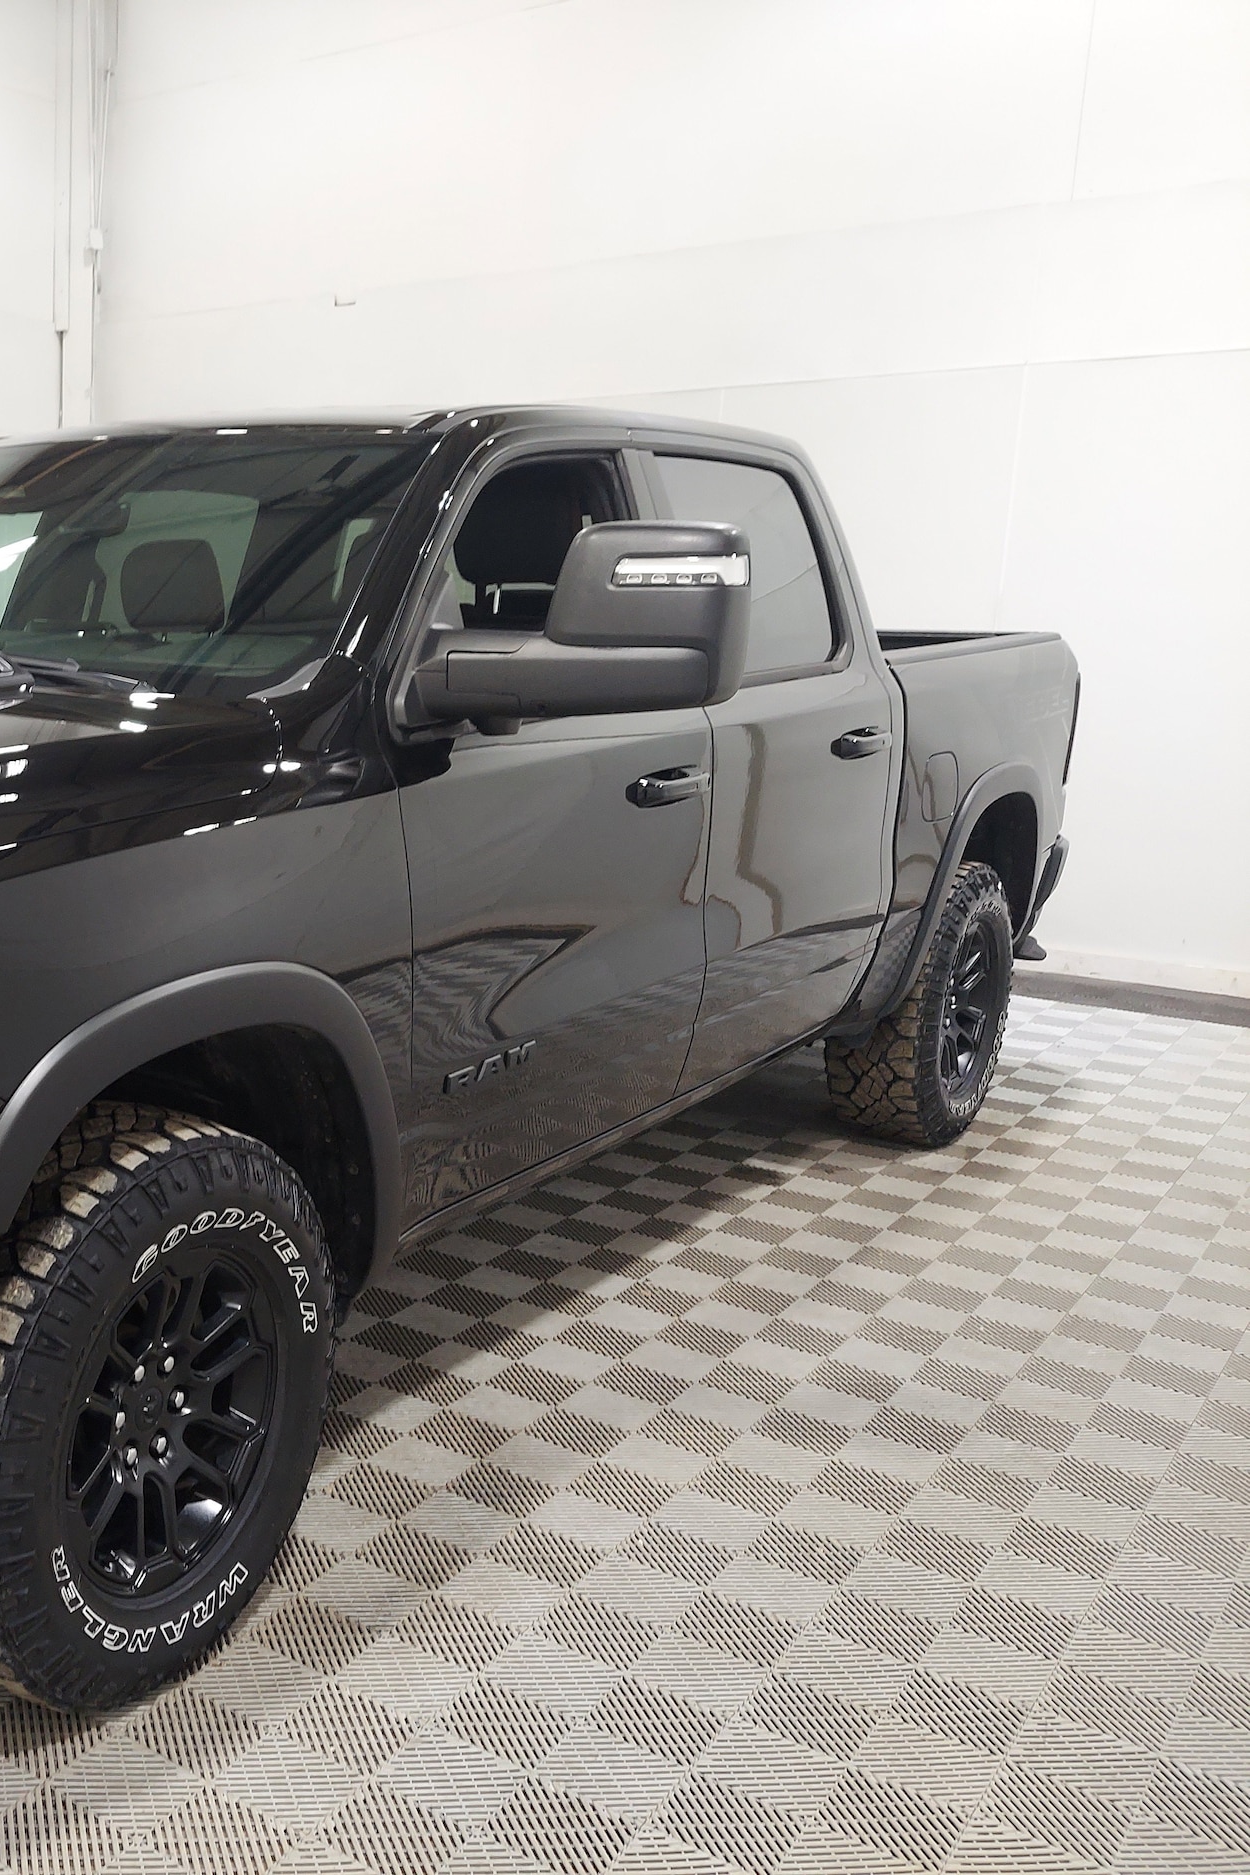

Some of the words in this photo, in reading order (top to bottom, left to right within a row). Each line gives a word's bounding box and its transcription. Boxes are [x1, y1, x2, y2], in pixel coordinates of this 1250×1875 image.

[442, 1039, 537, 1094] RAM
[131, 1206, 319, 1335] GOODYEAR
[50, 1543, 250, 1654] WRANGLER
